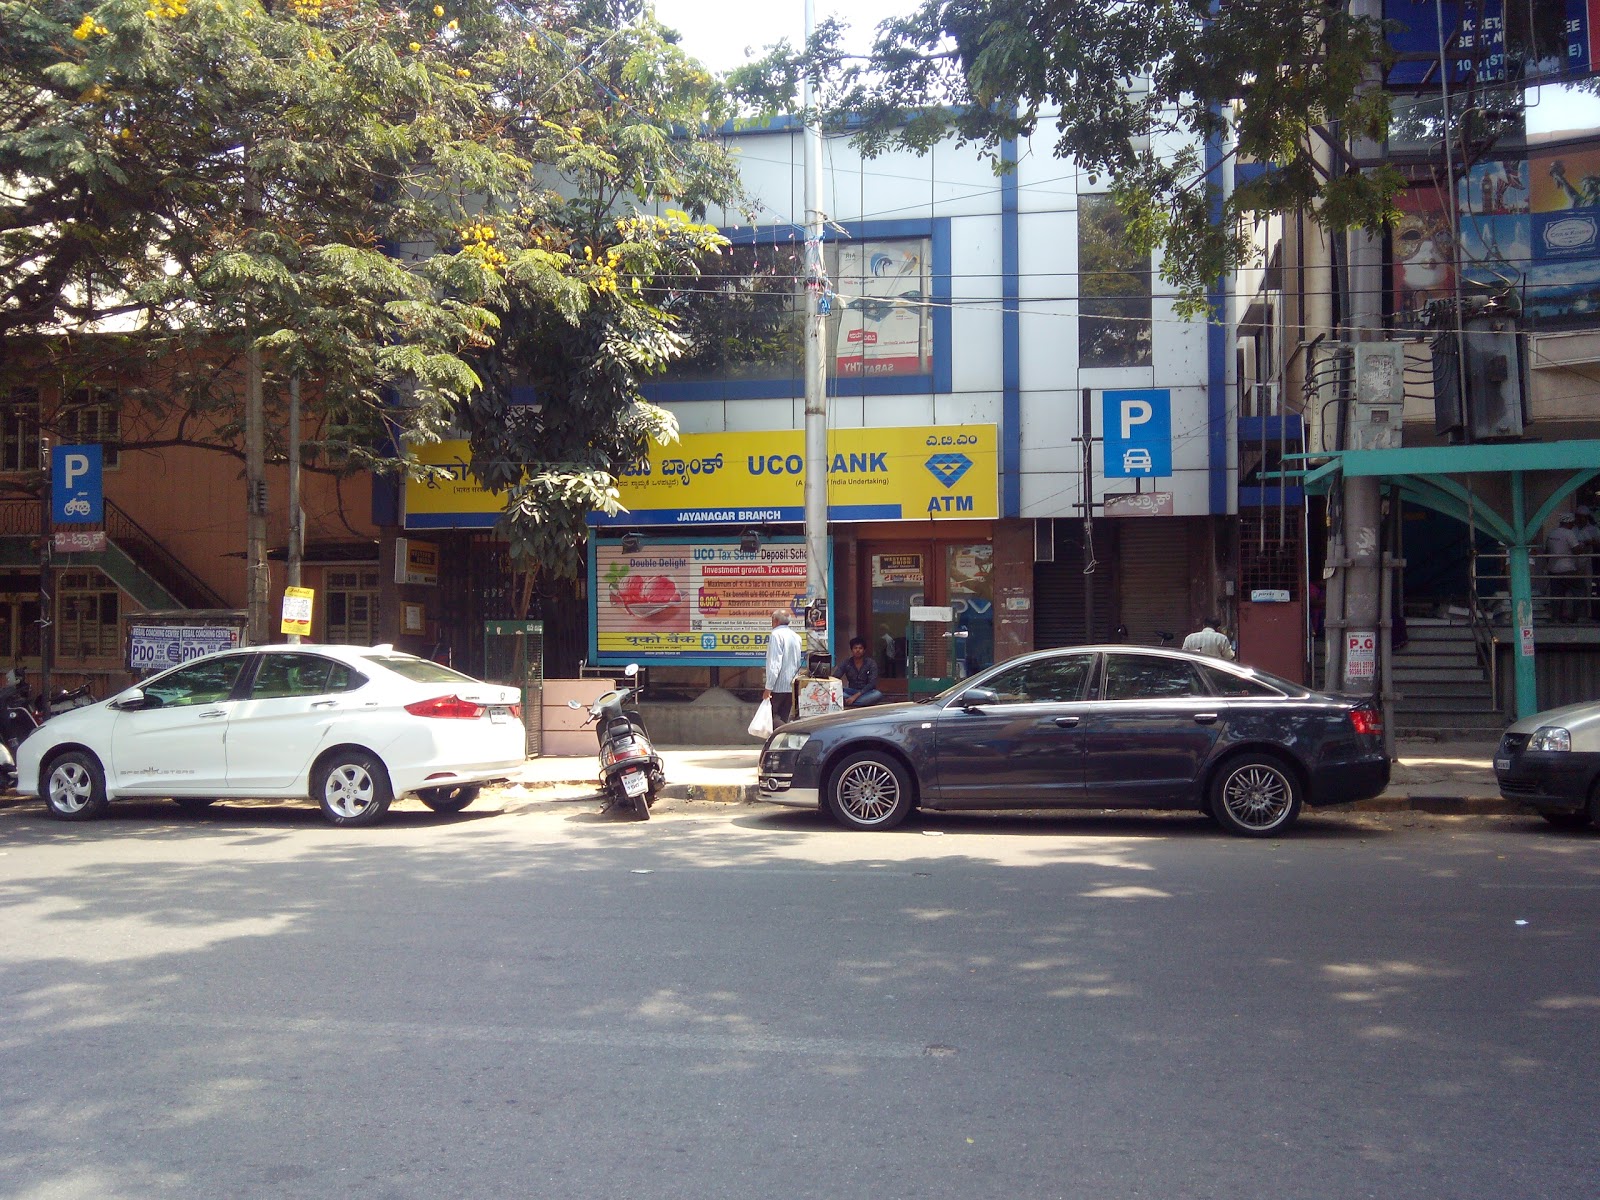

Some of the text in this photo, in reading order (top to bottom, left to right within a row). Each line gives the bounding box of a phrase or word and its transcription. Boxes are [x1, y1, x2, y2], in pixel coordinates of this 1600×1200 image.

[1121, 400, 1152, 439] P
[662, 453, 723, 486] ಬ್ಯಾಂಕ್
[748, 452, 888, 475] UCO ANK
[65, 454, 89, 489] P
[848, 477, 889, 486] Undertaking)
[927, 495, 973, 512] ATM
[677, 510, 781, 522] JAYANAGAR BRANCH
[694, 547, 807, 563] UCO Tax Saver Deposit Sche
[630, 558, 687, 569] Double Delight
[704, 565, 807, 576] Investment growth. Tax savings
[708, 580, 731, 588] Maximum
[772, 580, 793, 588] financial
[733, 590, 749, 598] benefit
[165, 629, 180, 638] CENTRE
[183, 630, 231, 638] REGAL COACHING CENTRE
[722, 634, 770, 645] UCO BA
[1349, 638, 1374, 650] P.G
[132, 645, 154, 661] PDO
